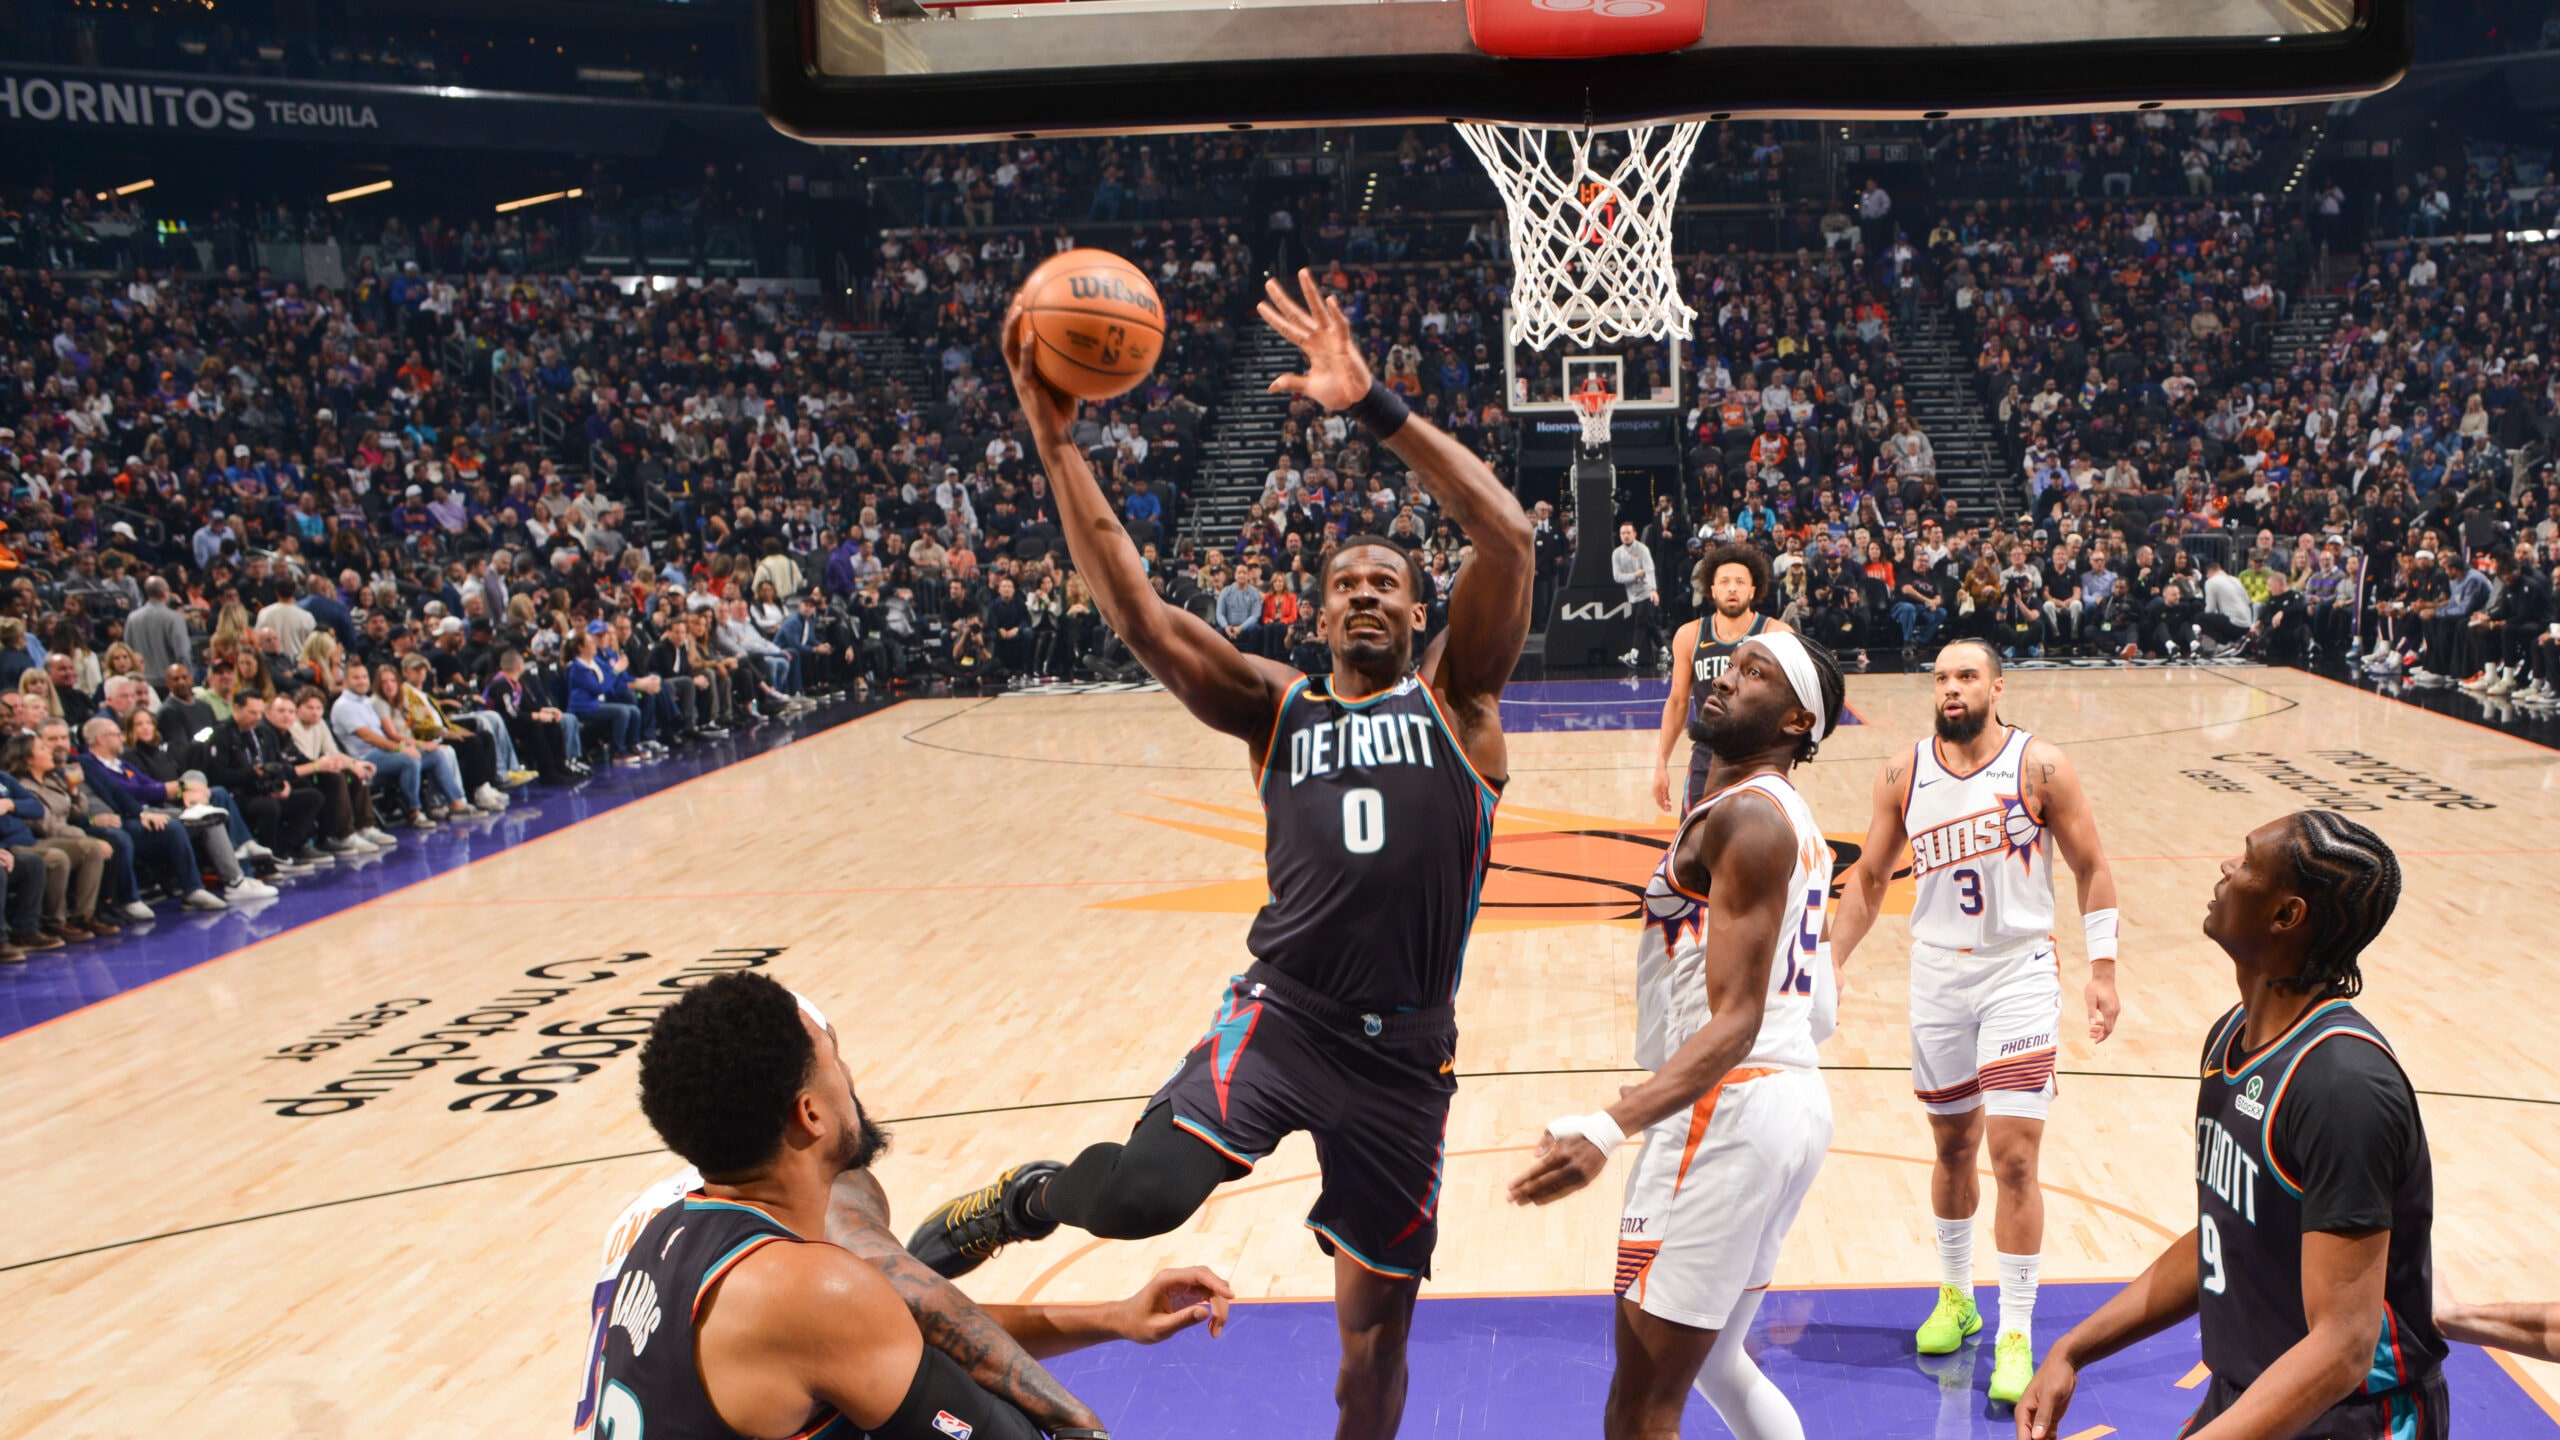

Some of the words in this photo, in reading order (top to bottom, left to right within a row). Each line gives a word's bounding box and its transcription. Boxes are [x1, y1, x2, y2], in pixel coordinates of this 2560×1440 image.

[265, 101, 378, 128] TEQUILA
[1069, 276, 1159, 318] Wilson
[1695, 655, 1731, 682] DETR
[1290, 712, 1434, 788] DETROIT
[1986, 770, 2014, 780] PayPal
[2307, 750, 2497, 809] mortgage
[1342, 787, 1385, 855] 0
[1912, 813, 2001, 875] SUNS
[1953, 869, 1984, 917] 3
[2000, 1033, 2050, 1056] PHOENIX
[2236, 1095, 2264, 1119] StockX
[2201, 1212, 2226, 1296] 9
[608, 1270, 661, 1357] HARRIS
